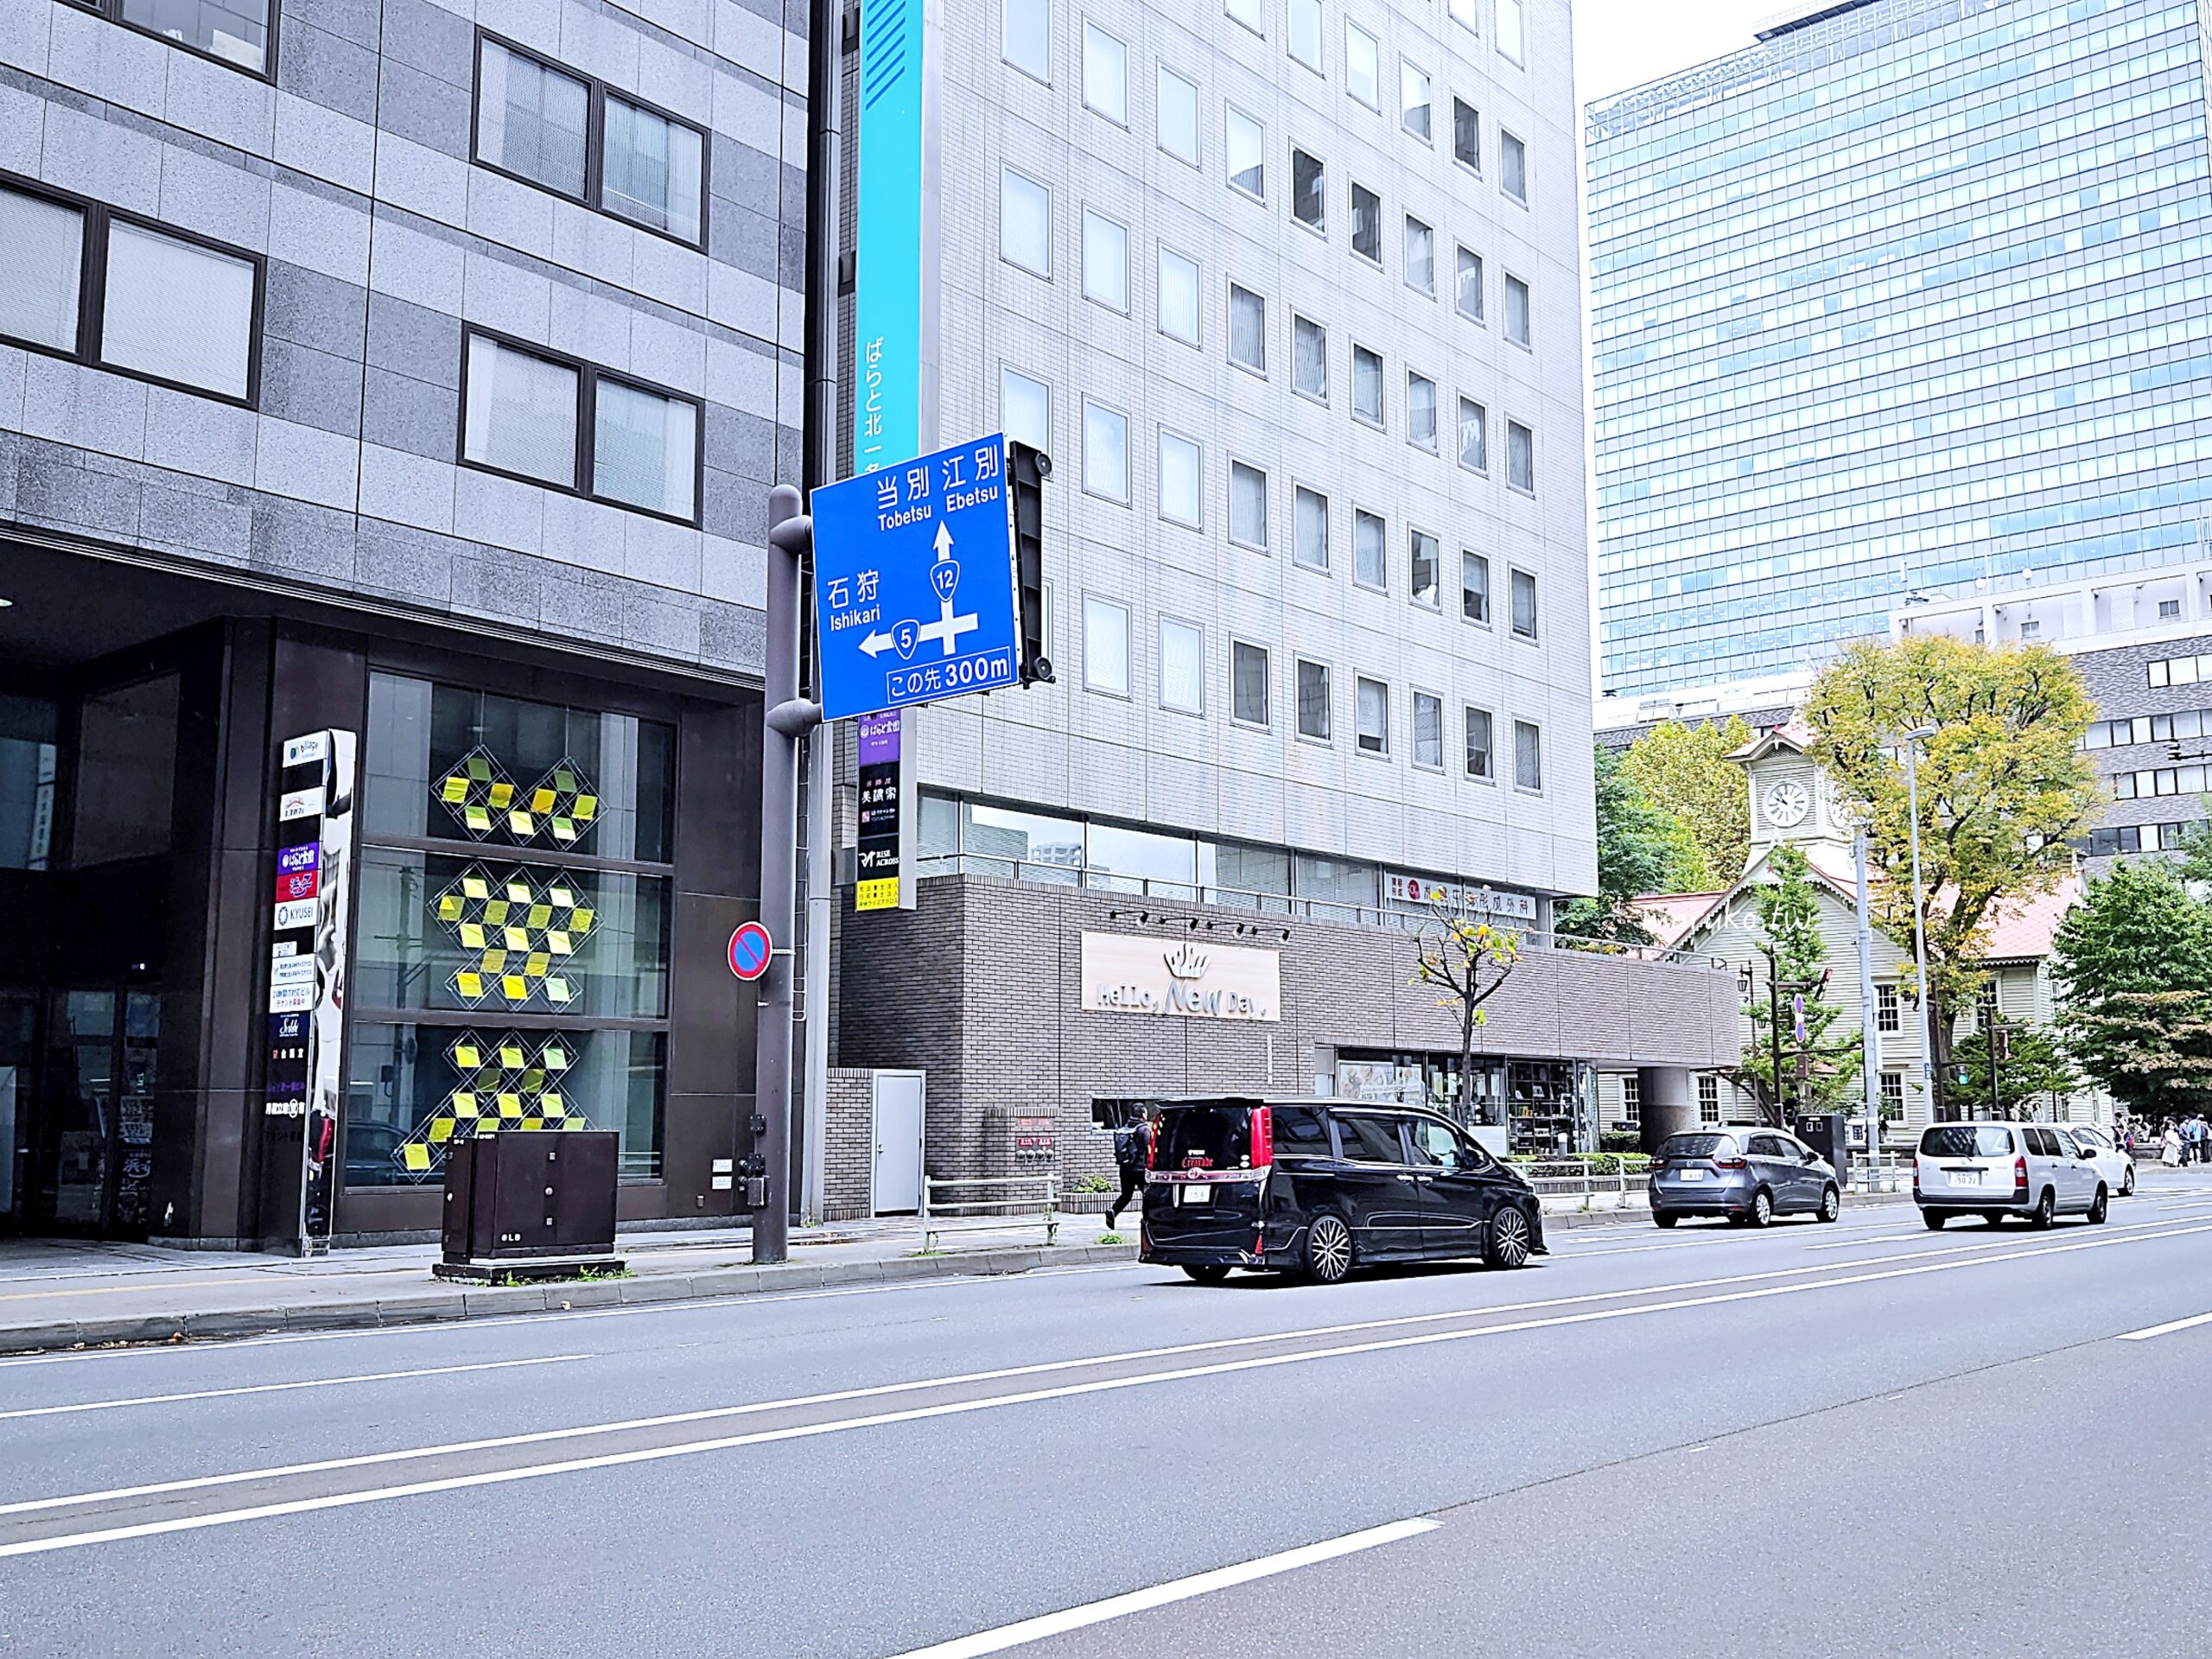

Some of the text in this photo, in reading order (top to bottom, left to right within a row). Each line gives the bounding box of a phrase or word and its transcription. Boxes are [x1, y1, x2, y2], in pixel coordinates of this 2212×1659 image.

[877, 443, 1000, 510] 当別 江別
[877, 485, 999, 531] Tobetsu Ebetsu
[827, 569, 880, 609] 石狩
[937, 569, 954, 590] 12
[830, 604, 881, 632] Ishikari
[900, 628, 912, 650] 5
[875, 857, 899, 867] ACROSS
[289, 906, 314, 920] KYUSEI
